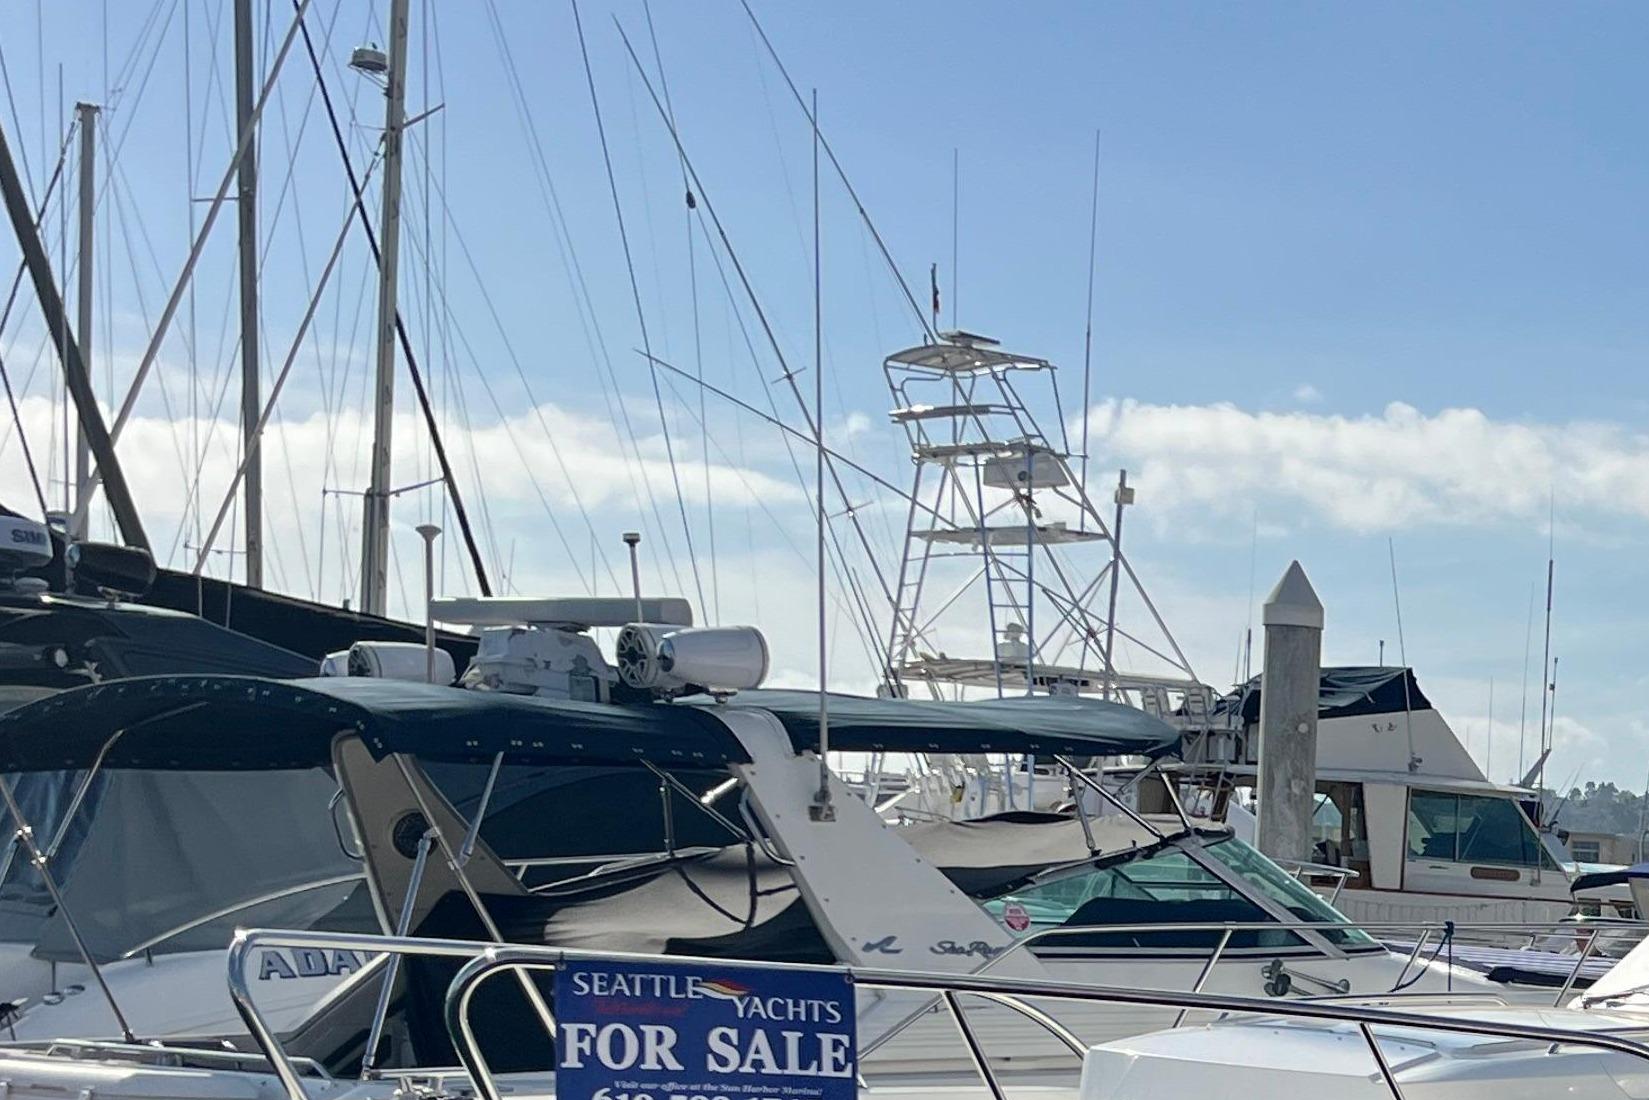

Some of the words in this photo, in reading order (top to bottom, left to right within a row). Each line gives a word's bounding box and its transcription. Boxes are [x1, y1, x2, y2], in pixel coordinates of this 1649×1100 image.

[572, 971, 703, 999] SEATTLE
[732, 996, 842, 1024] YACHTS
[560, 1022, 685, 1071] FOR
[706, 1026, 853, 1078] SALE
